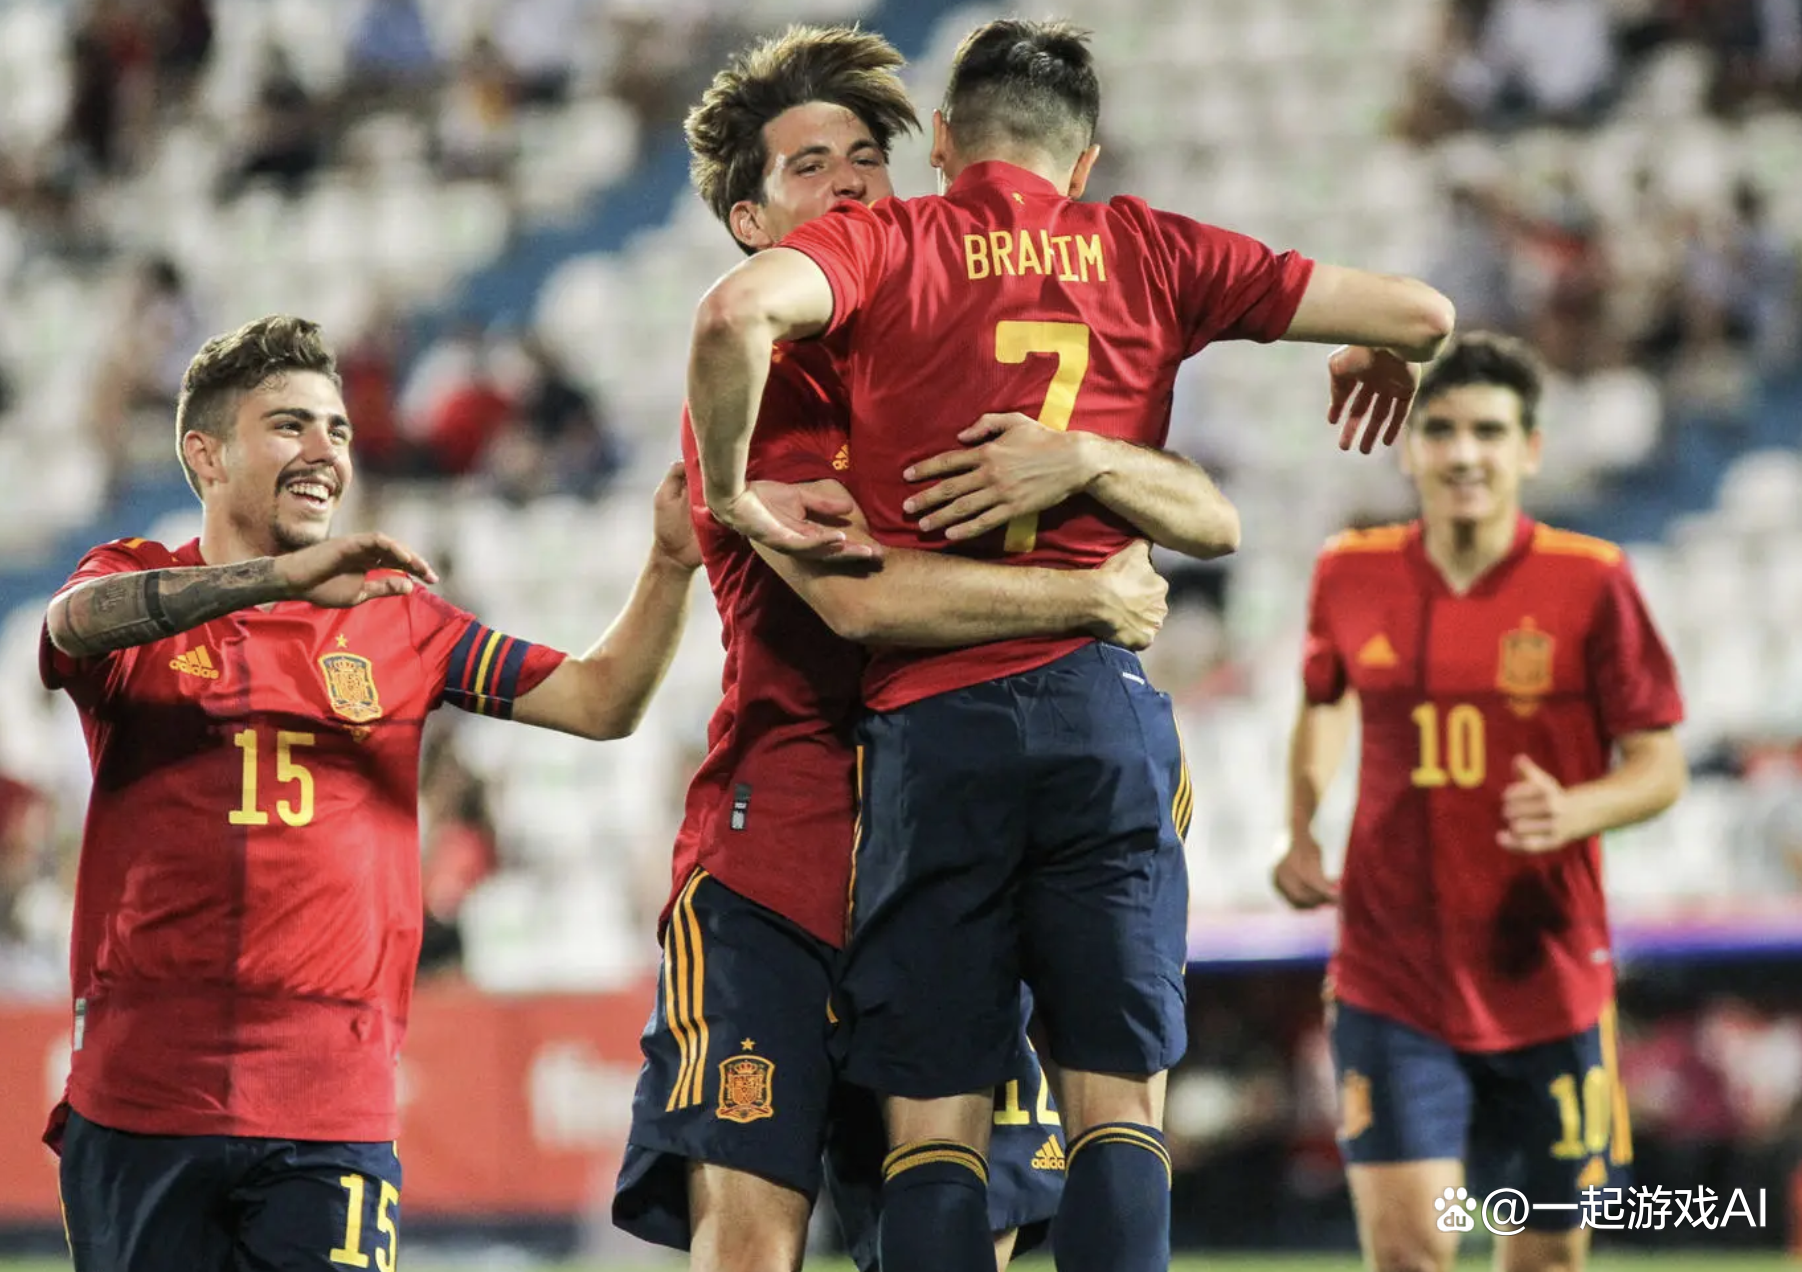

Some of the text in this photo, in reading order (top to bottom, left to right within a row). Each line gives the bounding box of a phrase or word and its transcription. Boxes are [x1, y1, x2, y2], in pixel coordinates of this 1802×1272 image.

[995, 320, 1090, 553] 7
[168, 659, 219, 680] adidas
[228, 728, 316, 827] 15
[1410, 701, 1487, 790] 10
[1031, 1157, 1066, 1171] adida
[330, 1174, 401, 1272] 15
